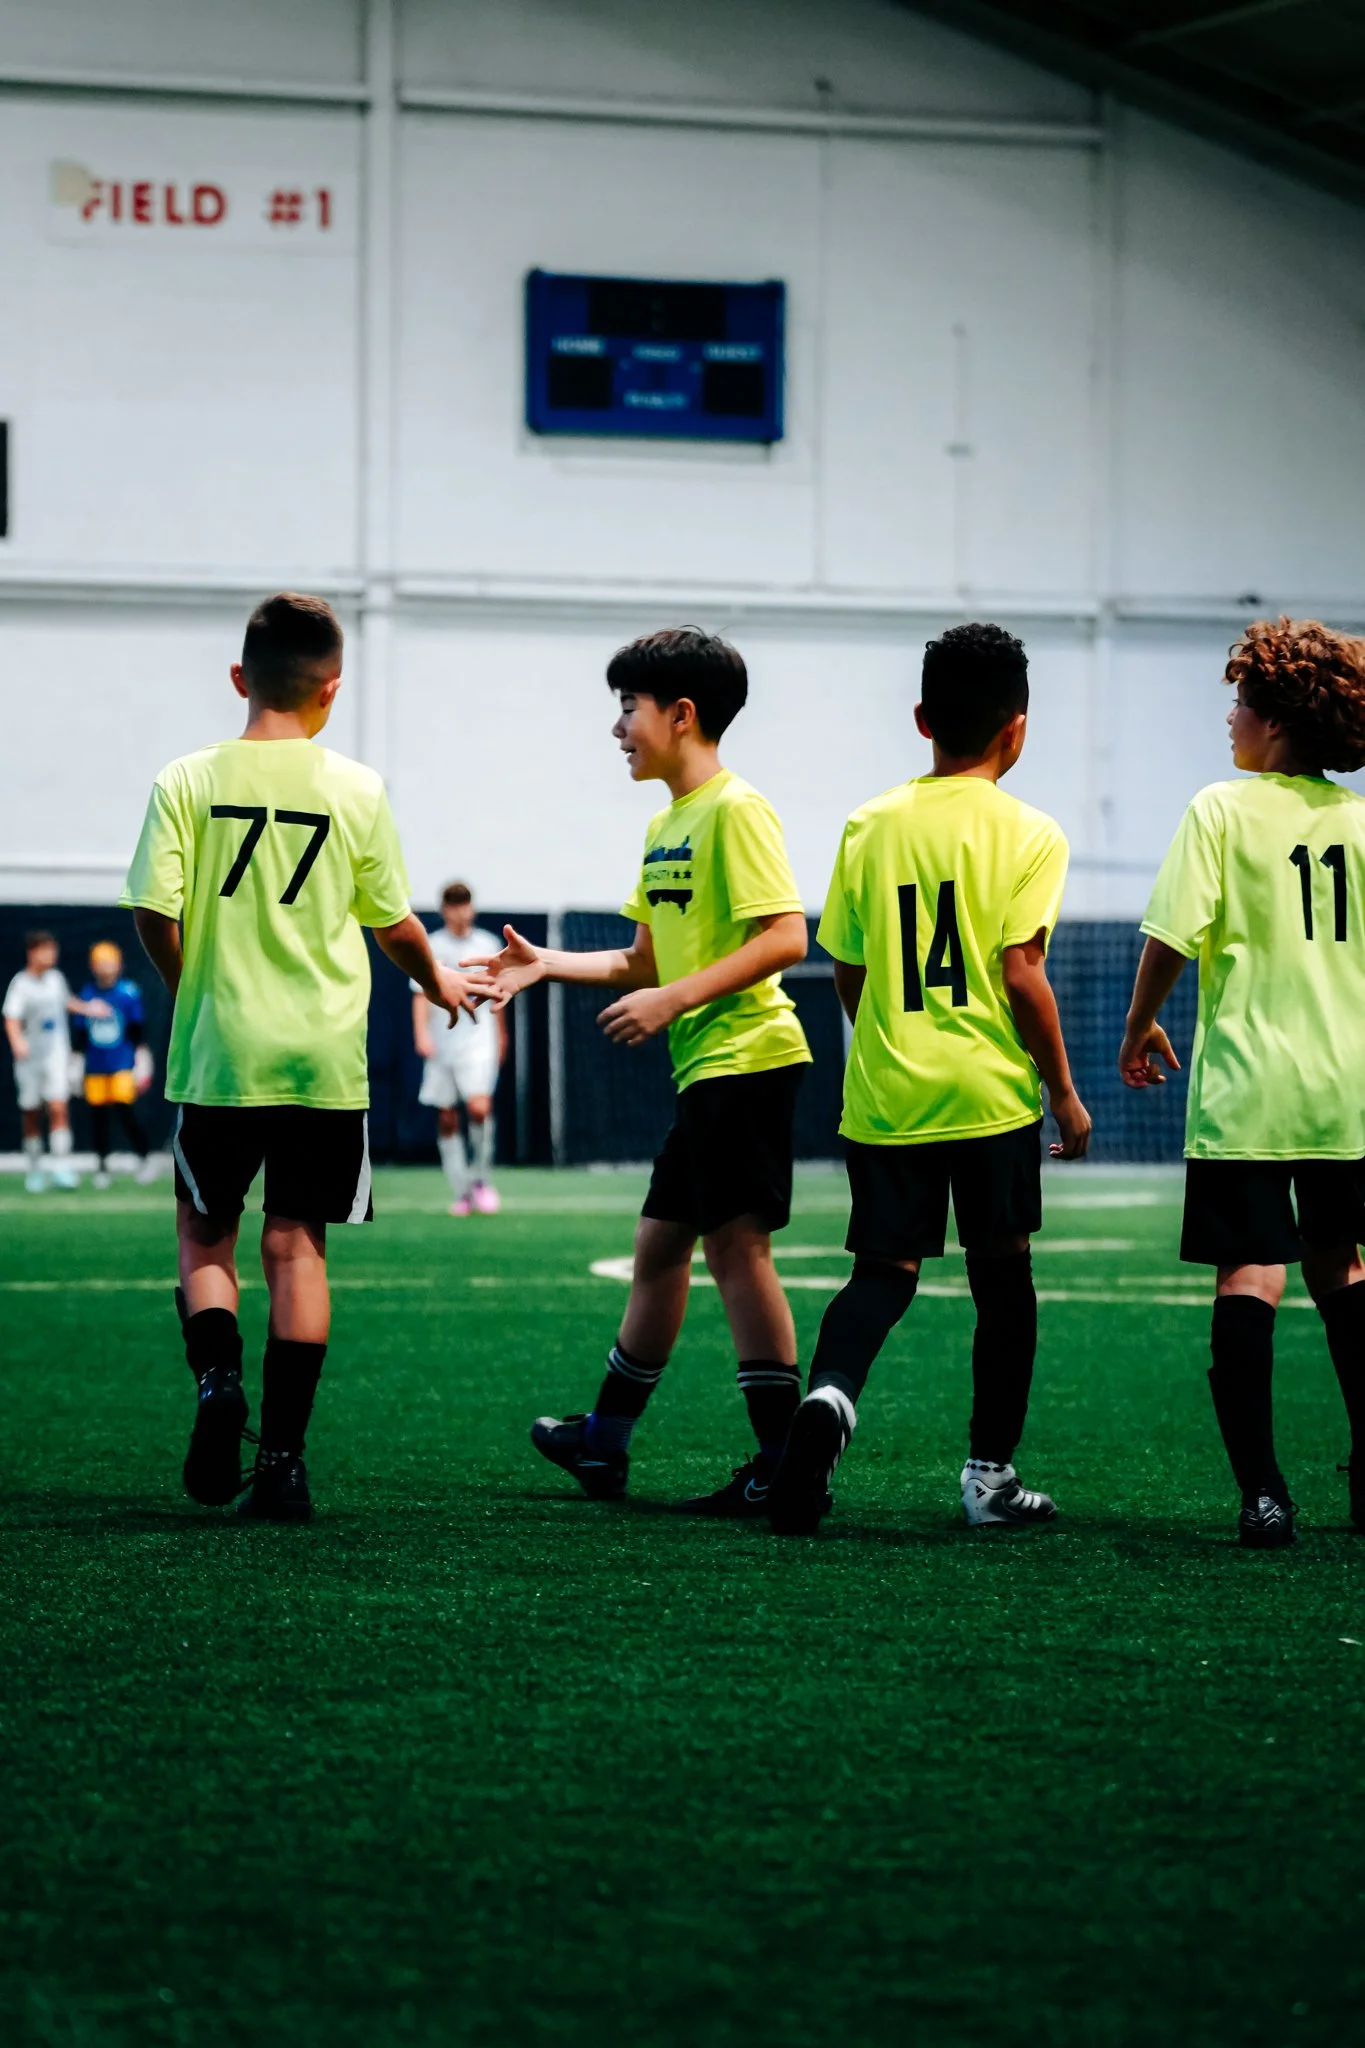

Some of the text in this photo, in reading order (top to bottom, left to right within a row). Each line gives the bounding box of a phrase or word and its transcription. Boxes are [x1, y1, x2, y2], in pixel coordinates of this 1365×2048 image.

[267, 186, 332, 230] #1
[210, 804, 330, 905] 77
[1288, 844, 1347, 942] 11
[897, 880, 969, 1012] 14
